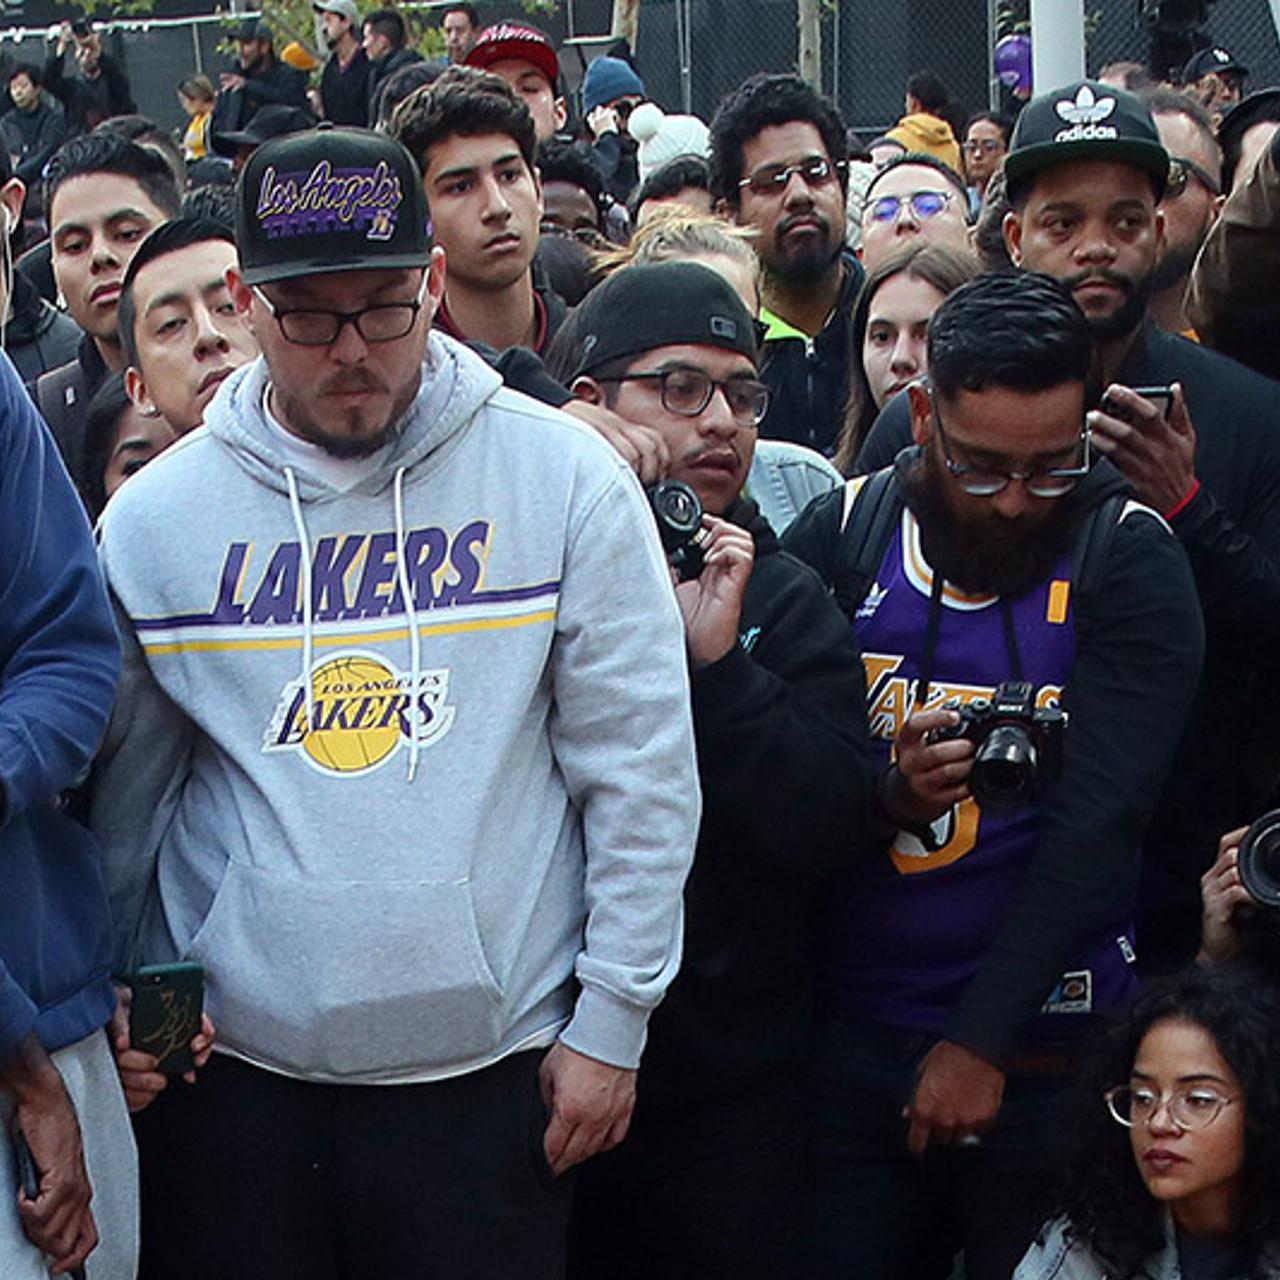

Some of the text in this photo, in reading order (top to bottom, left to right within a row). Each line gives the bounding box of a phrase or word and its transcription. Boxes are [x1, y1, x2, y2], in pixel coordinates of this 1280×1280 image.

[1054, 124, 1118, 143] adidas
[256, 159, 403, 222] Los Angeles
[211, 520, 495, 625] LAKERS
[270, 684, 443, 746] LAKERS
[322, 682, 354, 695] LOS
